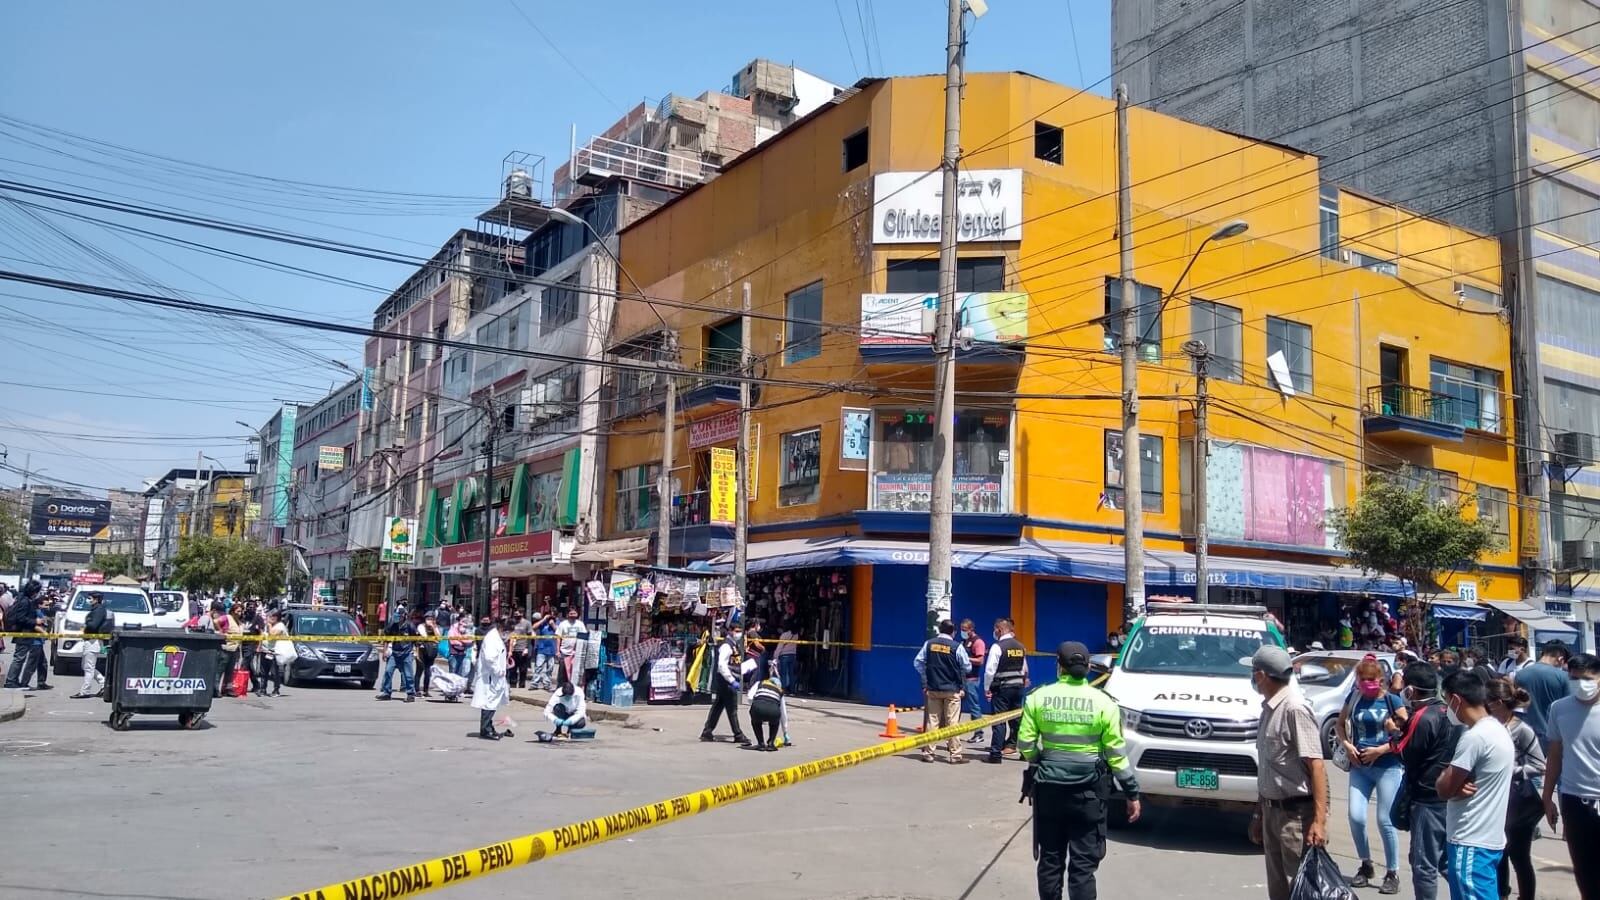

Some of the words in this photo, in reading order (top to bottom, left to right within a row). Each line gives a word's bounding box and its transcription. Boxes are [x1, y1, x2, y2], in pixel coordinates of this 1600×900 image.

[957, 207, 1007, 237] ental
[714, 461, 734, 471] 613
[60, 504, 96, 514] Dardos
[491, 541, 529, 554] RODRIGUEZ
[1183, 572, 1228, 584] GOTEX
[1460, 587, 1475, 601] 613
[1042, 696, 1094, 713] POLICIA
[553, 821, 600, 851] POLICIA
[604, 810, 652, 836] NACIONAL
[655, 804, 669, 822] DEL
[672, 796, 691, 817] PERU
[342, 864, 433, 900] NACIONAL
[442, 854, 472, 884] DEL
[478, 842, 514, 873] PERU
